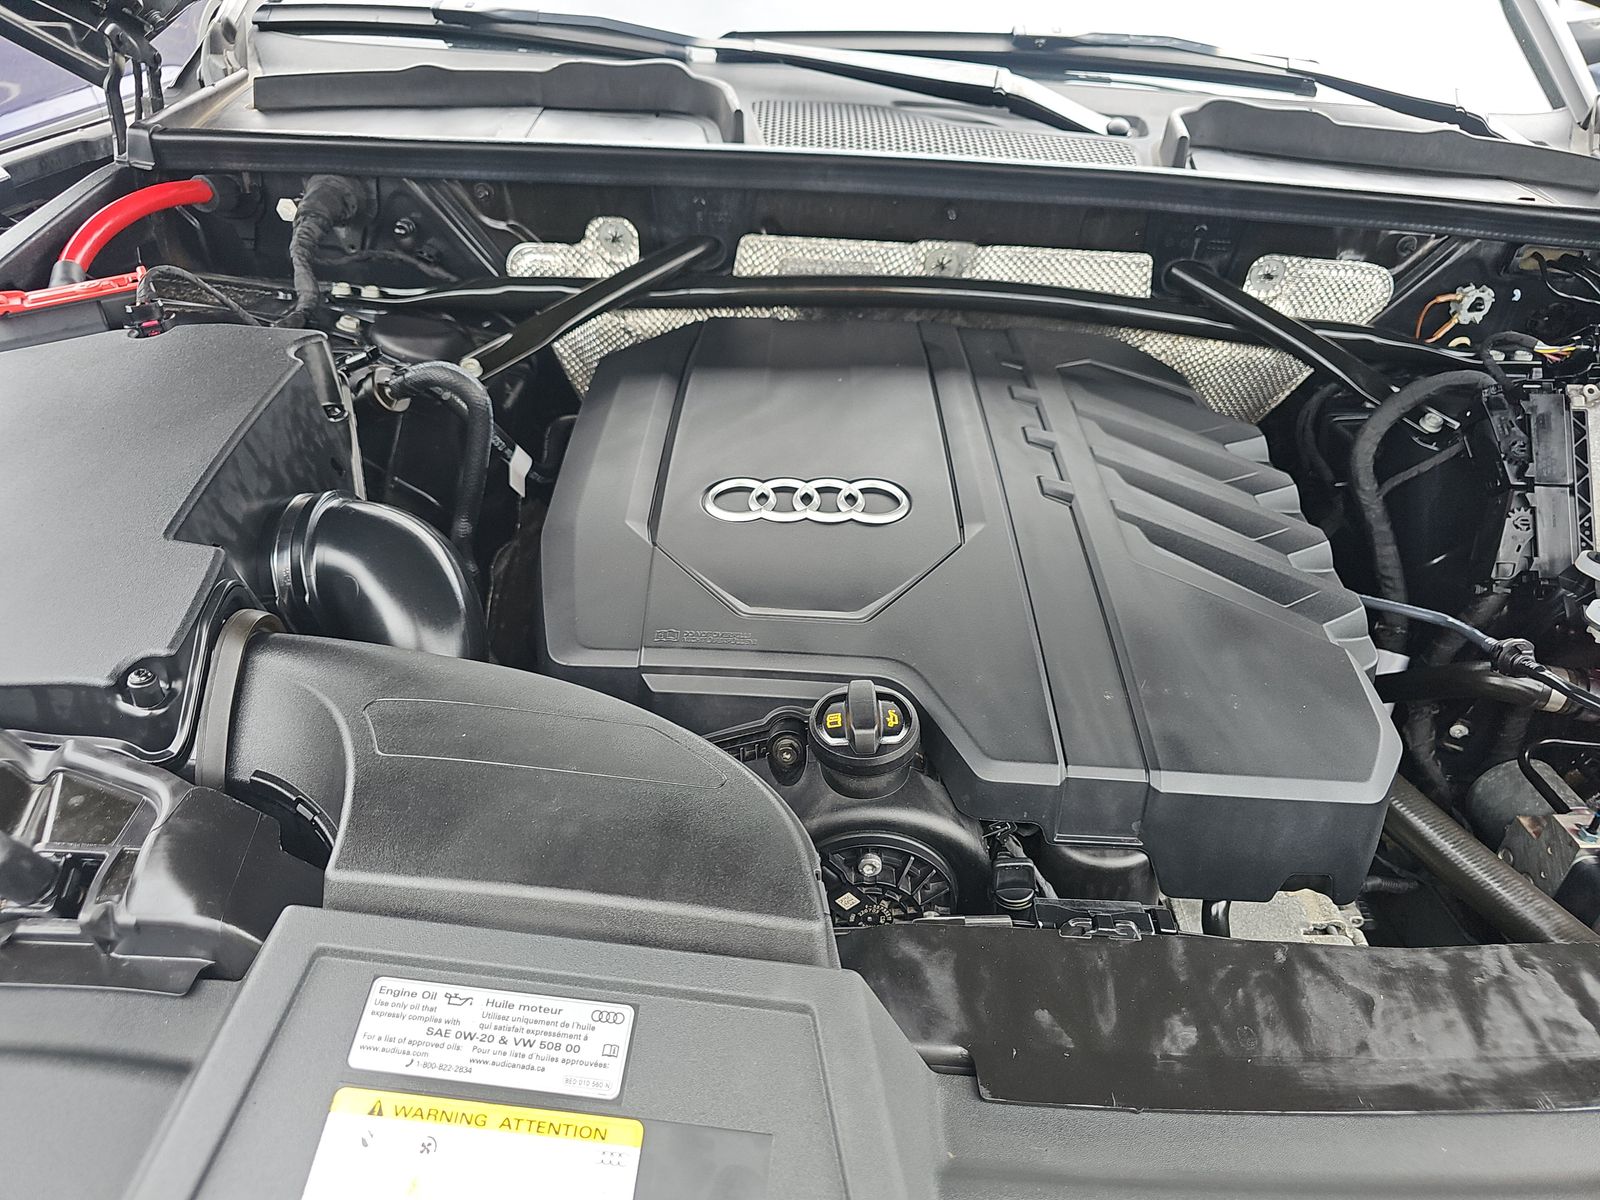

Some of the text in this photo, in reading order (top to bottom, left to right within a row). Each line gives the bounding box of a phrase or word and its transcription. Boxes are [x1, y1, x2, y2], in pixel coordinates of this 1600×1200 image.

[379, 986, 438, 1000] Engine Oil
[374, 999, 389, 1007] Use
[391, 1001, 408, 1010] only
[422, 1004, 437, 1012] that
[485, 998, 564, 1016] Huile moteur
[371, 1010, 460, 1026] expressly complies with
[482, 1011, 510, 1022] Utilisez
[512, 1016, 558, 1028] uniquement
[560, 1020, 570, 1028] de
[426, 1026, 580, 1054] SAE 0W-20 & VW 508 00
[478, 1022, 492, 1030] qui
[494, 1024, 524, 1034] satisfait
[526, 1028, 580, 1041] expressément
[362, 1032, 376, 1040] For
[384, 1034, 396, 1043] list
[408, 1038, 444, 1049] approved
[446, 1042, 462, 1051] oils:
[360, 1044, 428, 1058] www.audiusa.com
[472, 1045, 490, 1054] Pour
[492, 1048, 507, 1056] une
[510, 1050, 525, 1058] liste
[561, 1057, 610, 1069] approuvées:
[416, 1060, 472, 1074] 1-800-822-2834
[469, 1058, 546, 1072] www.audicanada.ca
[394, 1104, 608, 1140] WARNING ATTENTION
